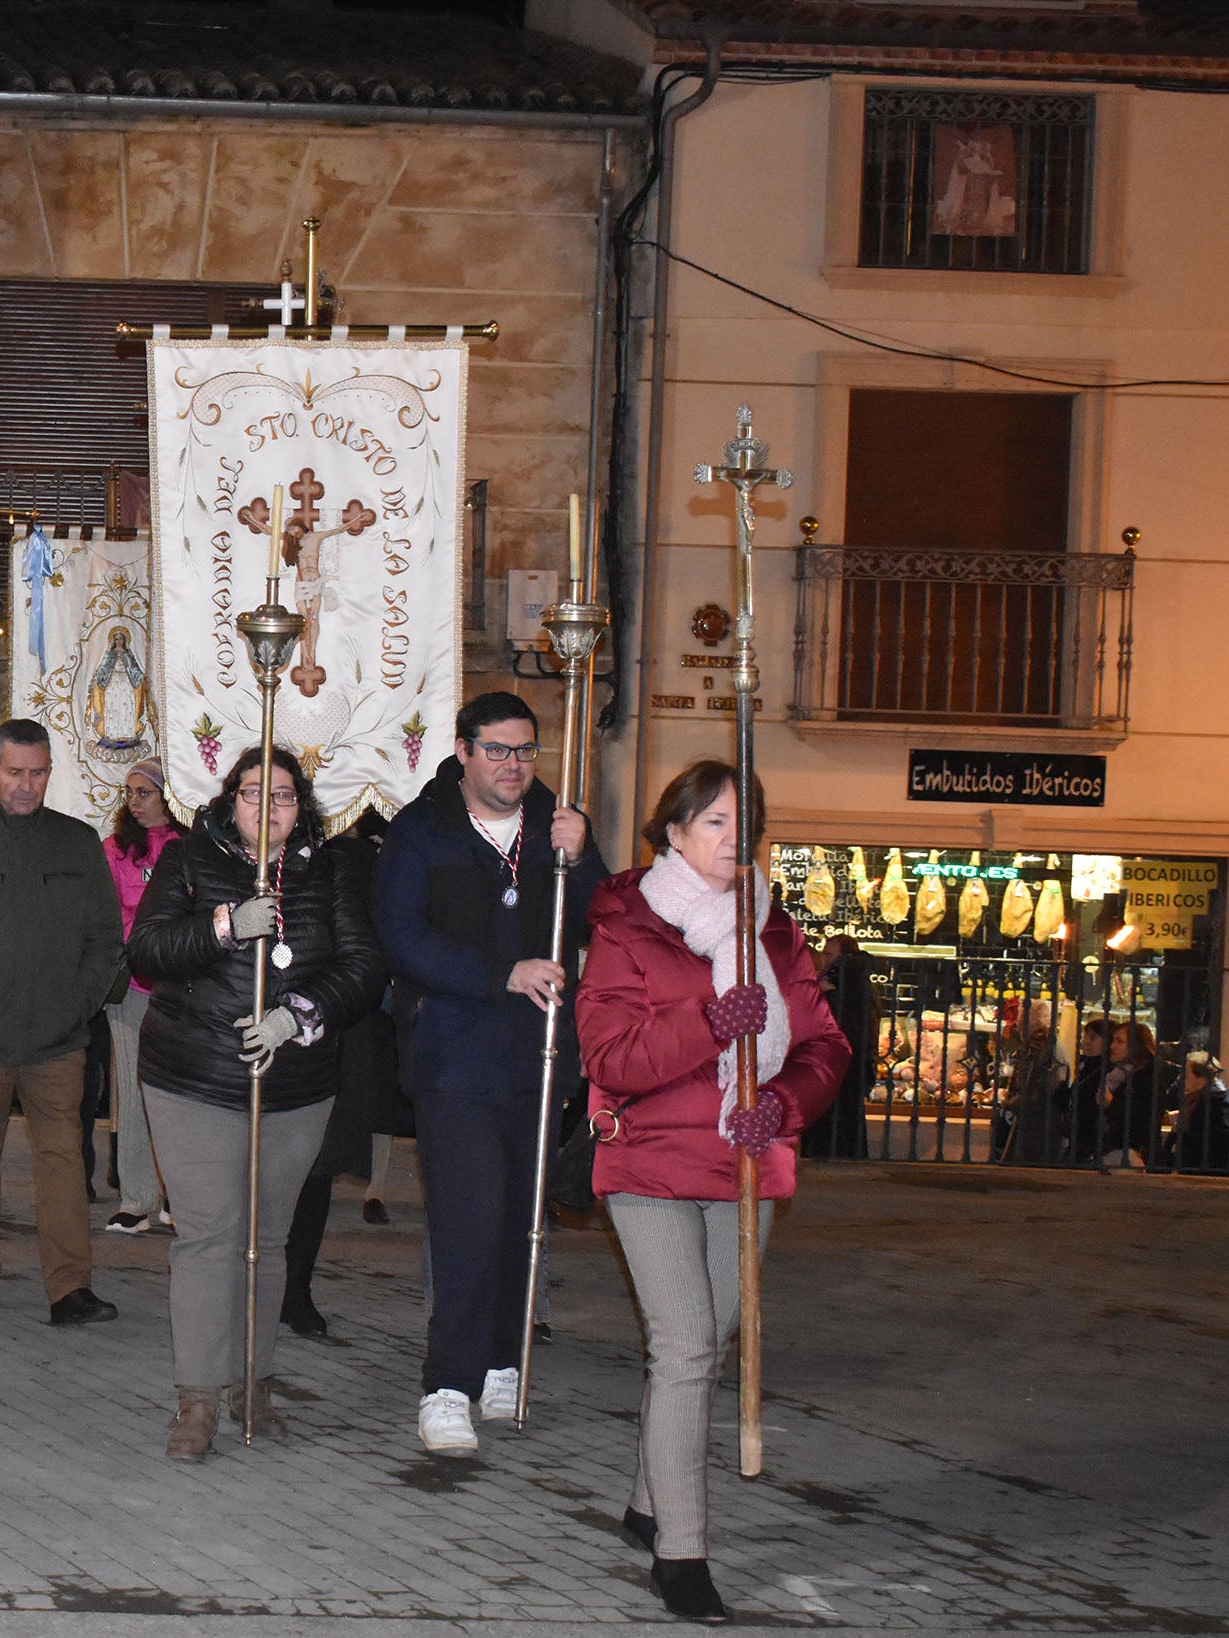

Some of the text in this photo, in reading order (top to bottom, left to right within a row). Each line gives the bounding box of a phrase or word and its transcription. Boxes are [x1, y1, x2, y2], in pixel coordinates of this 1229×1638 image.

[310, 412, 397, 476] CRISTO
[213, 456, 244, 516] DEL
[380, 486, 410, 520] DE
[382, 531, 412, 576] LA
[211, 530, 237, 689] COFRADIA
[381, 586, 410, 690] SALUD
[912, 759, 1102, 797] Embutidos Ibéricos
[1123, 867, 1216, 882] BOCADILLO
[1145, 922, 1189, 938] 3,90€
